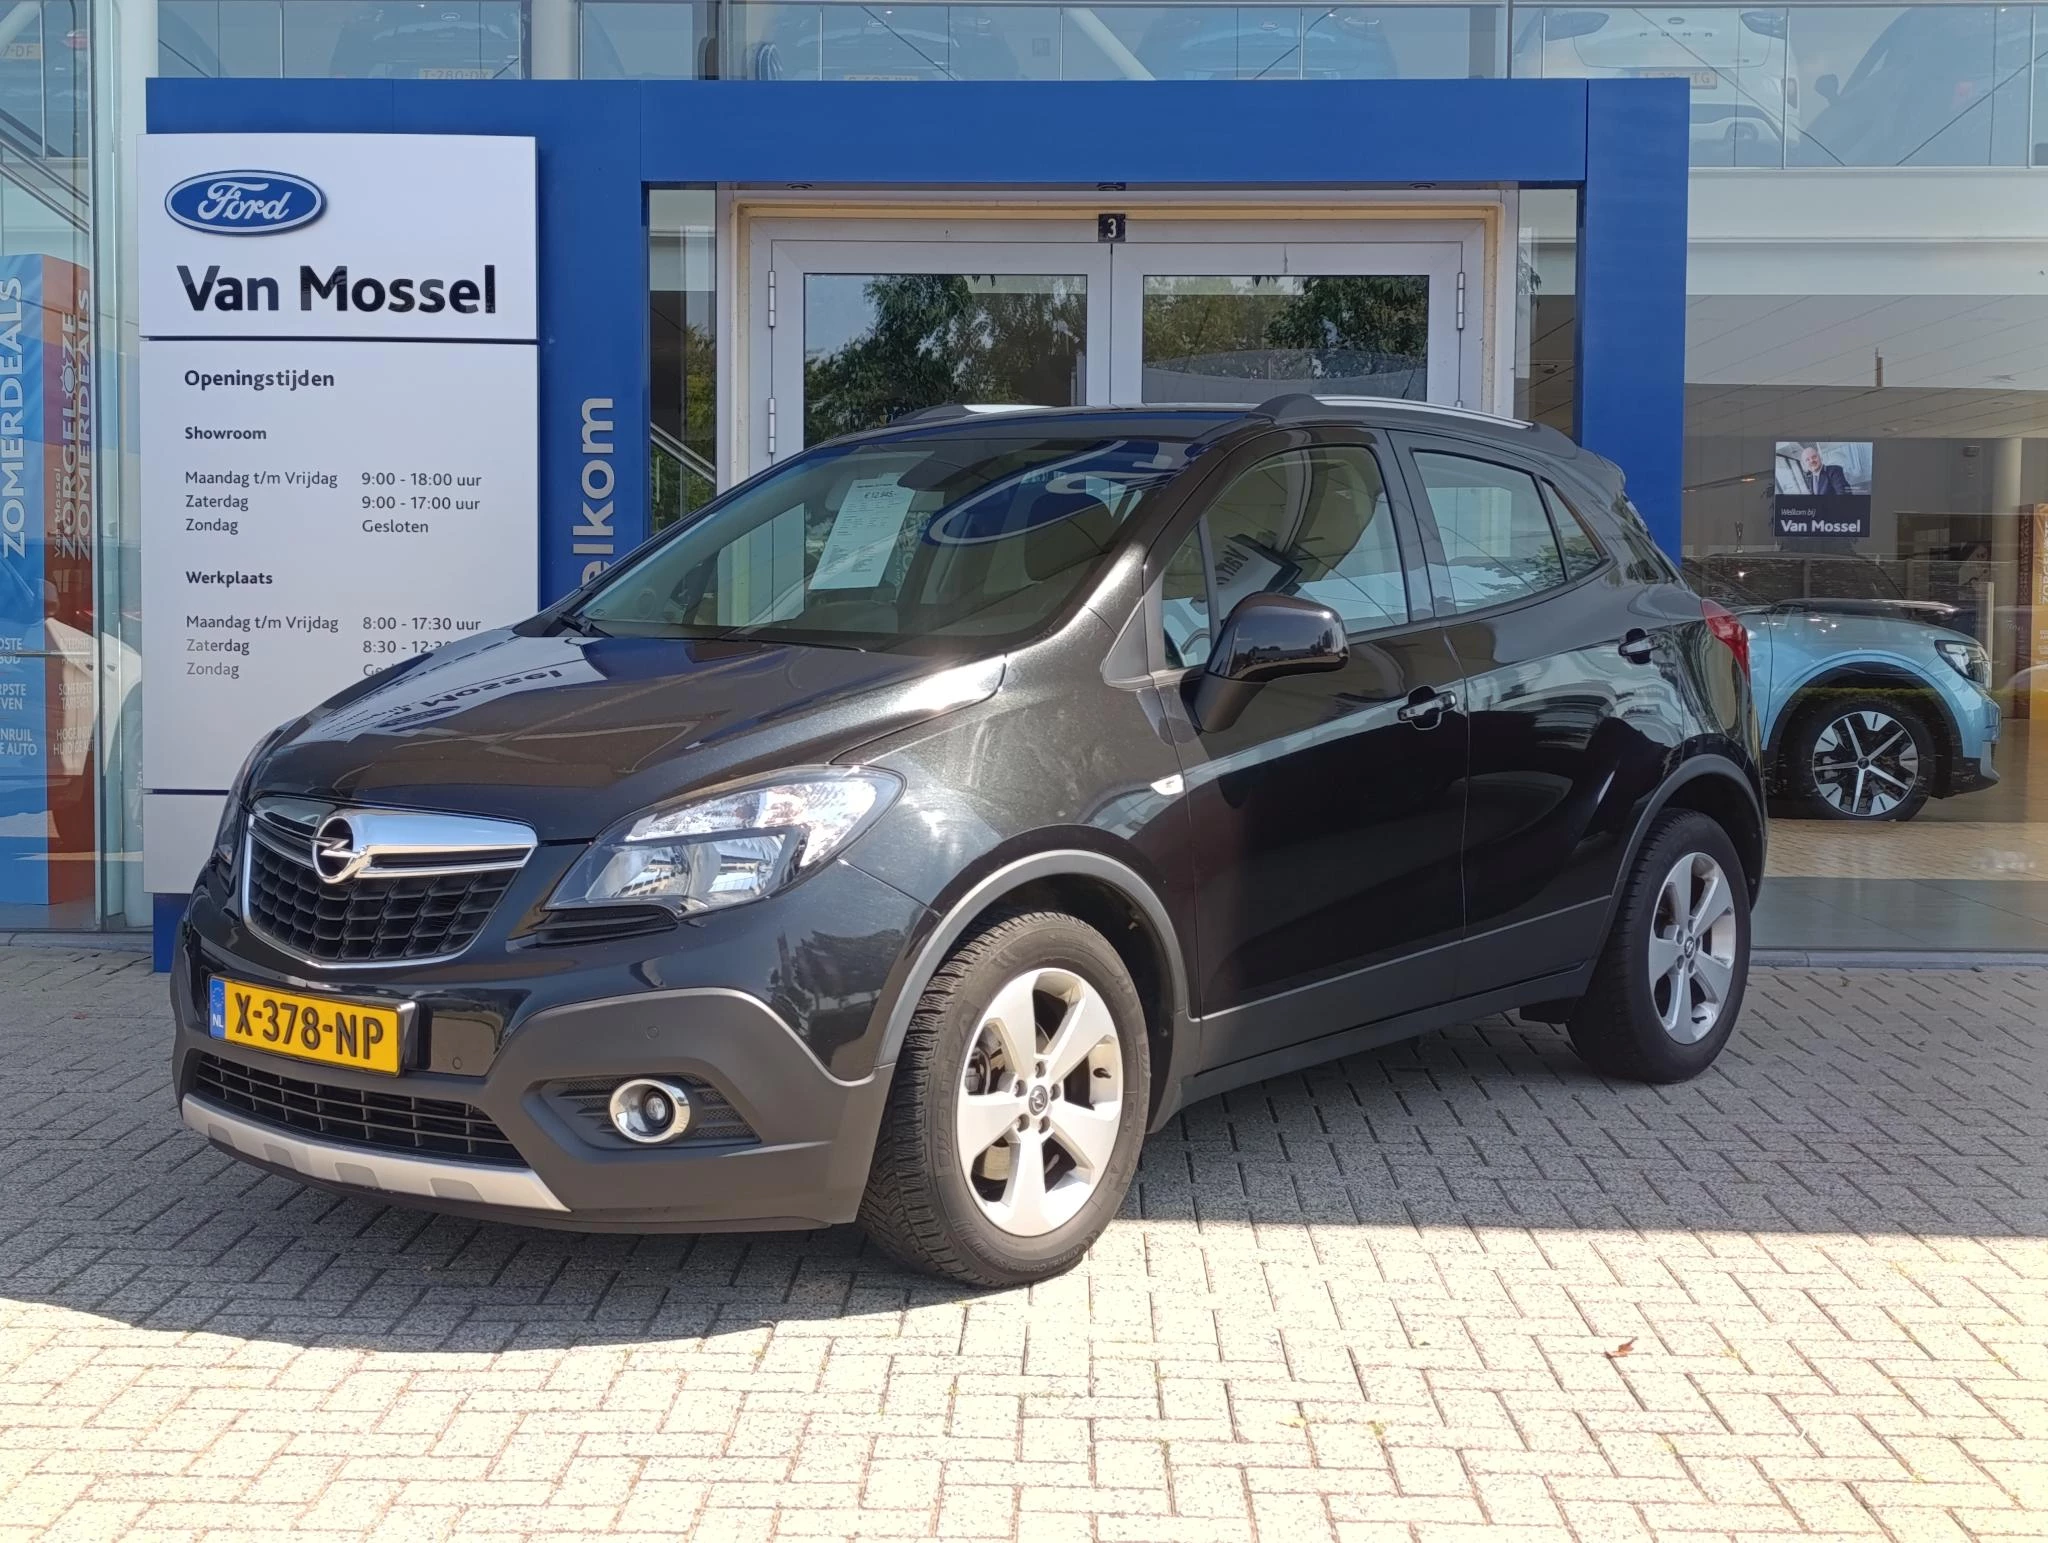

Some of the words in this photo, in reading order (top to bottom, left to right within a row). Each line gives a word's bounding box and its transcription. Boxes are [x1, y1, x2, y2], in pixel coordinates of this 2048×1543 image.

[197, 181, 291, 220] Ford
[1107, 218, 1117, 238] 3
[176, 265, 279, 311] Van
[300, 265, 496, 314] Mossel
[185, 369, 334, 391] Openingstijden
[0, 276, 26, 560] ZOMERDEALS
[185, 426, 266, 440] Showroom
[186, 470, 249, 488] Maandag
[254, 470, 281, 485] t/m
[285, 471, 338, 489] Vrijdag
[362, 472, 395, 486] 9:00
[411, 473, 452, 486] 18:00
[456, 477, 481, 487] uur
[186, 494, 249, 512] Zaterdag
[362, 496, 395, 509] 9:00
[411, 497, 452, 510] 17:00
[455, 501, 480, 511] uur
[1781, 508, 1806, 516] Welkom
[186, 518, 239, 535] Zondag
[362, 520, 429, 533] Gesloten
[1781, 519, 1807, 532] Van
[1812, 519, 1860, 532] Mossel
[186, 571, 273, 588] Werkplaats
[187, 615, 250, 633] Maandag
[255, 615, 281, 630] t/m
[286, 616, 339, 634] Vrijdag
[363, 617, 396, 630] 8:00
[412, 618, 452, 631] 17:30
[456, 621, 482, 631] uur
[187, 639, 250, 656] Zaterdag
[363, 641, 396, 654] 8:30
[187, 662, 239, 679] Zondag
[0, 698, 23, 710] VEN
[7, 742, 37, 756] AUTO
[212, 1013, 224, 1028] NL
[234, 993, 384, 1060] X-378-NP
